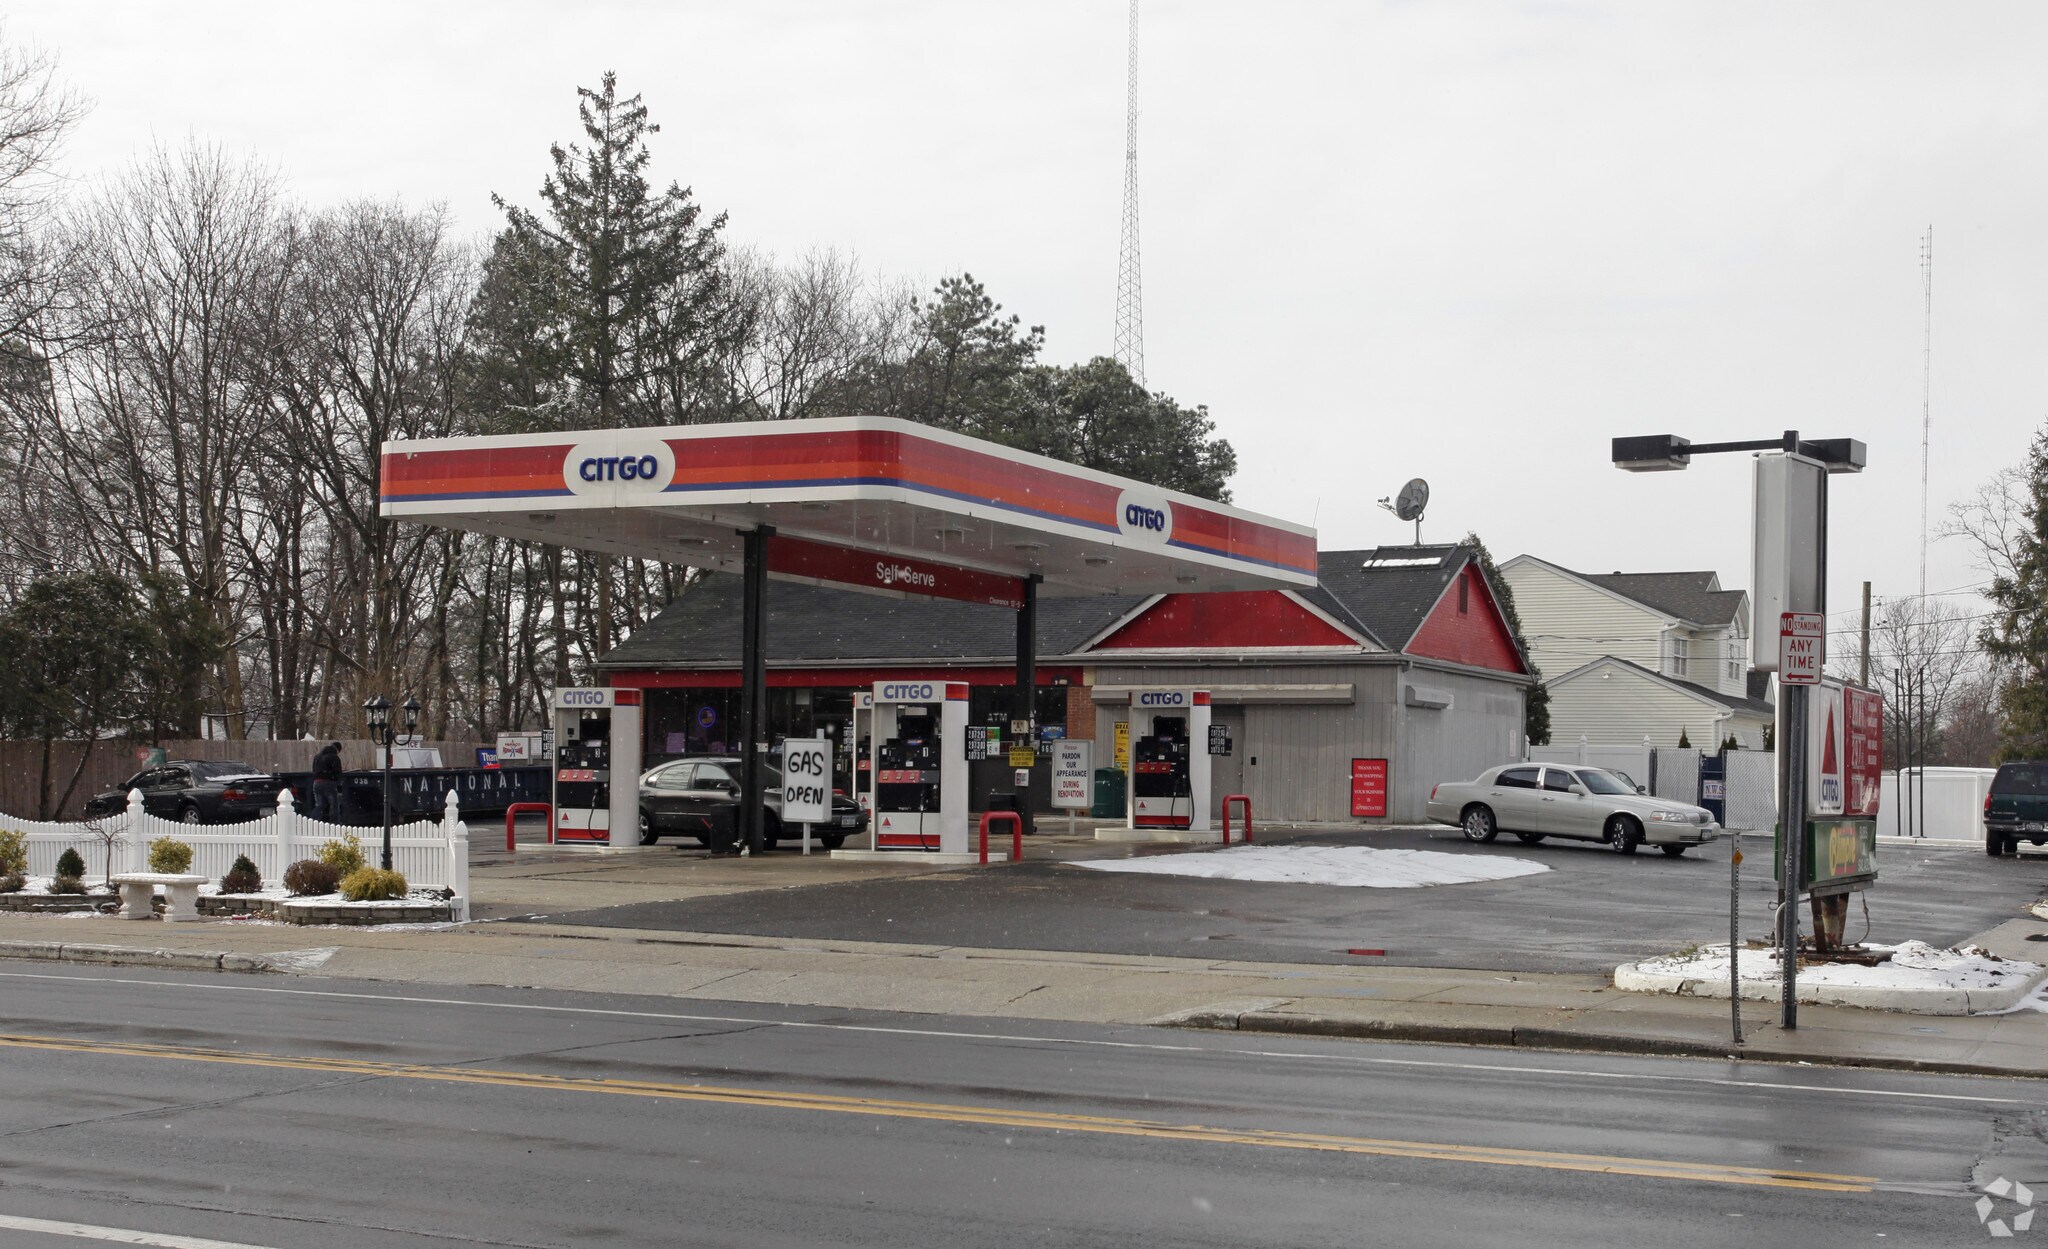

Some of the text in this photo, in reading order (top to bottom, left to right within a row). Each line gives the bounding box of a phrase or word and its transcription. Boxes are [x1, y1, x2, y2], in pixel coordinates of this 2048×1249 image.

[579, 454, 658, 482] CITGO
[1126, 503, 1165, 532] CITGO
[1780, 618, 1821, 632] NO STANDING
[1789, 639, 1813, 653] ANY
[1787, 655, 1814, 669] TIME
[563, 691, 604, 705] CITGO
[883, 684, 933, 699] CITGO
[1141, 693, 1183, 705] CITGO
[481, 752, 498, 762] Than
[788, 751, 824, 776] GAS
[403, 772, 521, 794] NATIONAL
[1821, 778, 1839, 802] CITGO
[786, 786, 824, 805] OPEN
